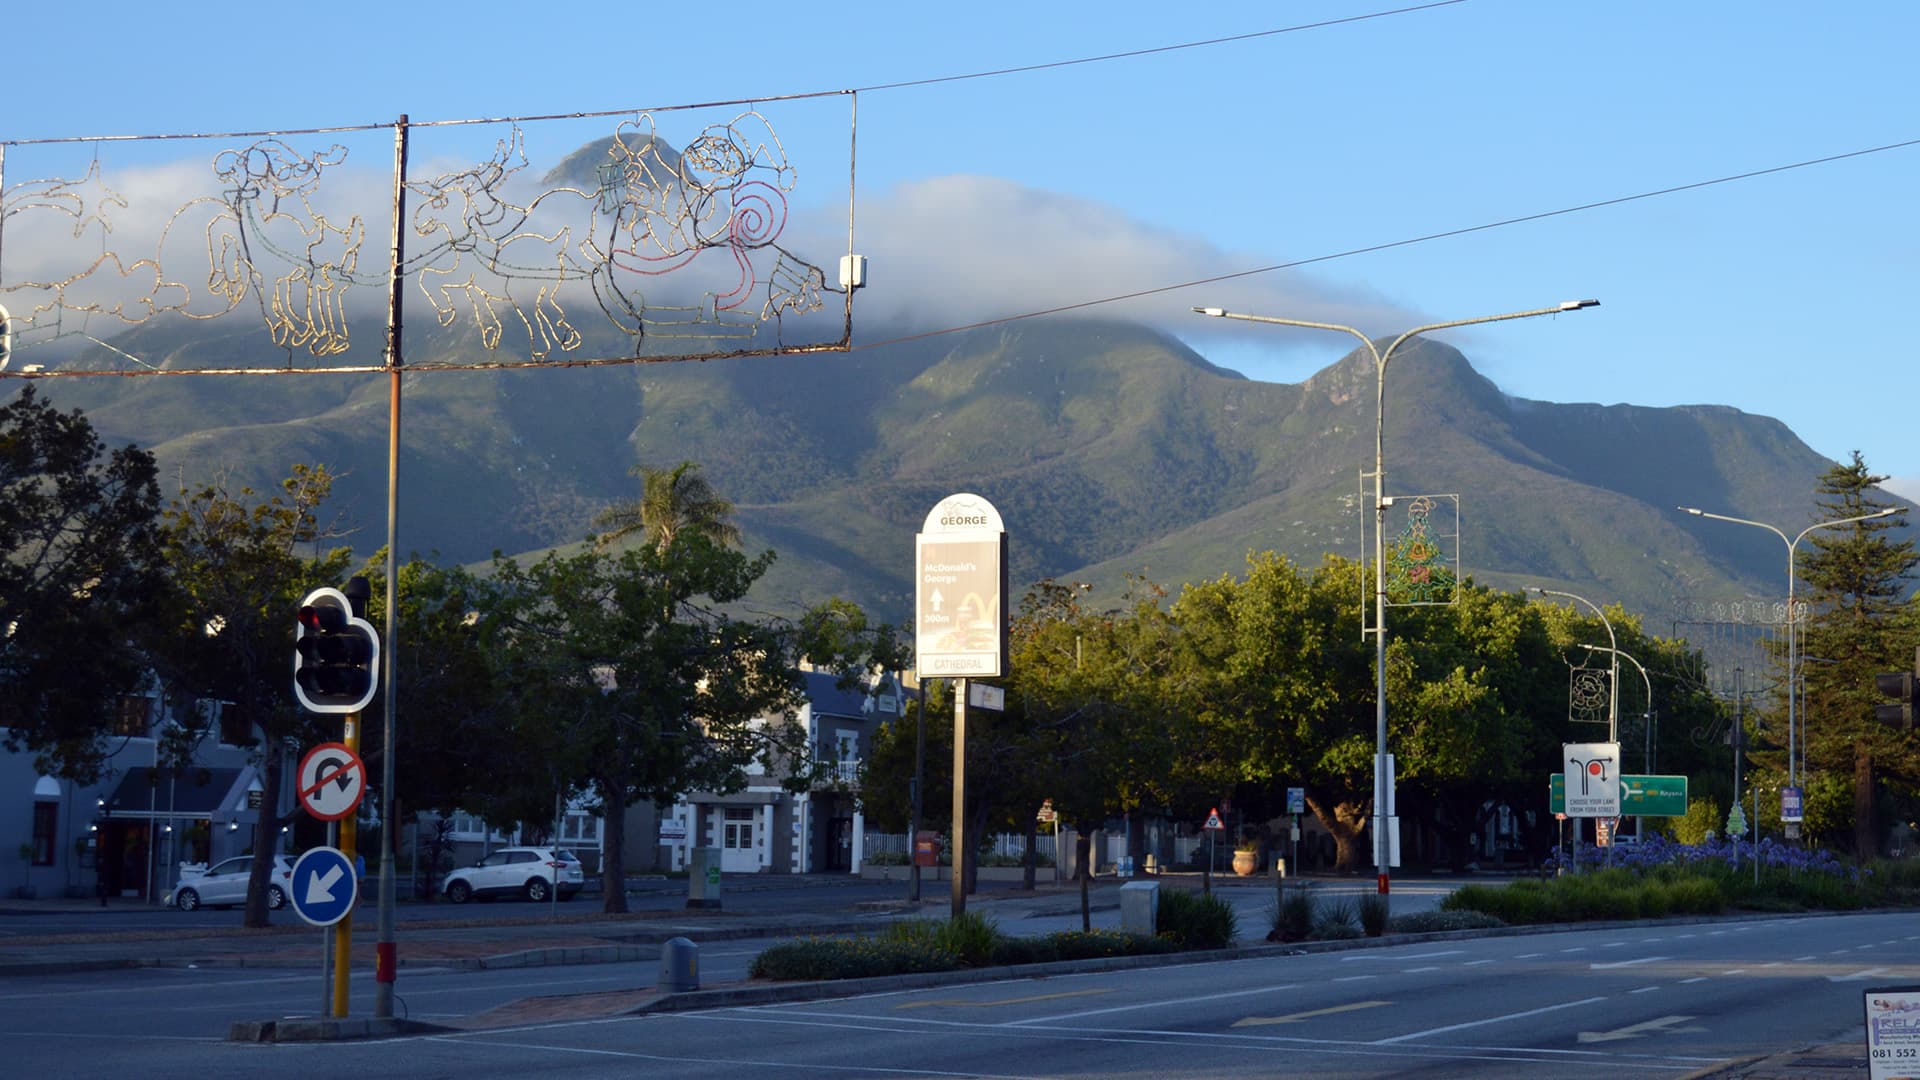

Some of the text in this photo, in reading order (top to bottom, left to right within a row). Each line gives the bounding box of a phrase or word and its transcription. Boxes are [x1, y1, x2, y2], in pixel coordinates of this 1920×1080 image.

[940, 516, 987, 526] GEORGE
[924, 562, 977, 573] McDonald's
[924, 574, 957, 585] George
[934, 658, 983, 670] CATHEDRAL
[1872, 1048, 1917, 1058] 081 552
